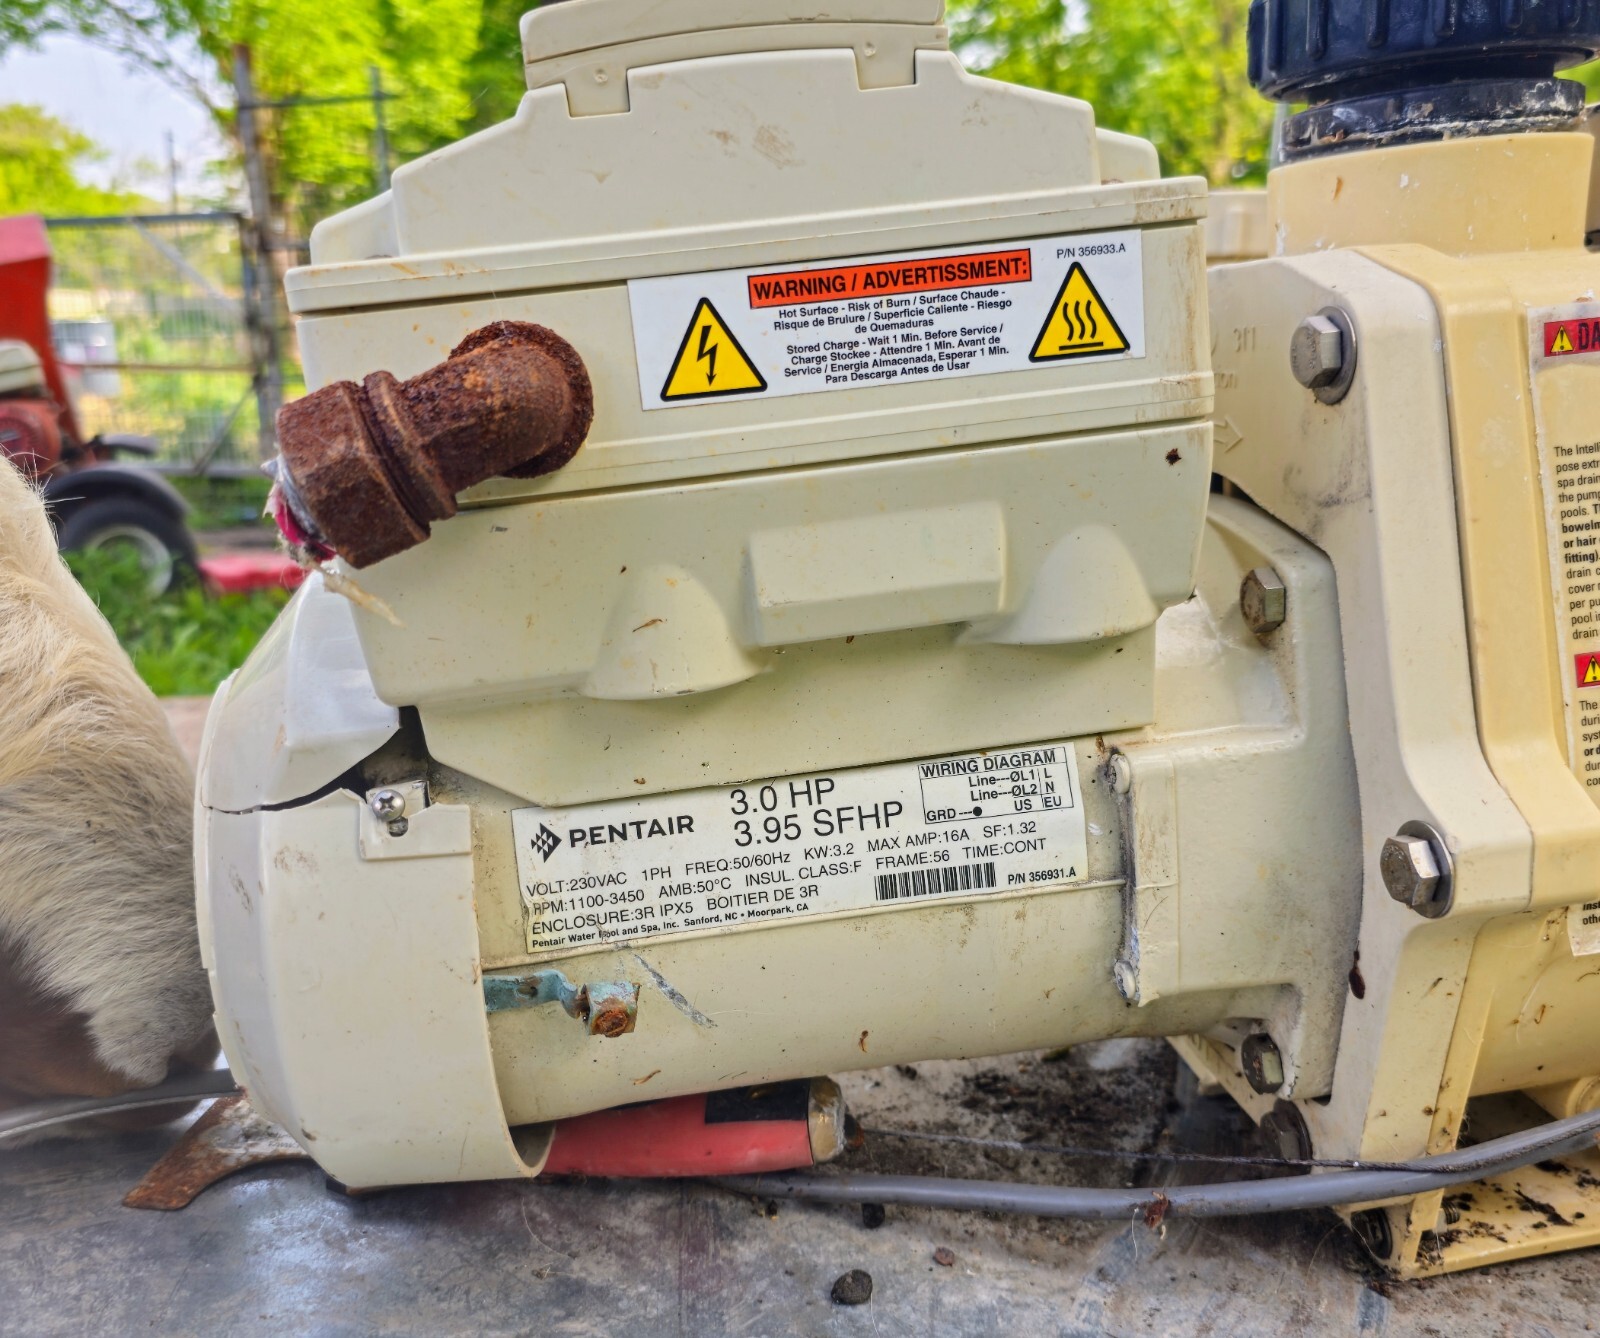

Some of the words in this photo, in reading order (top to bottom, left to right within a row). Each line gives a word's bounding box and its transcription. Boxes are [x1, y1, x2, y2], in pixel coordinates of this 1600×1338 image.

[1056, 248, 1075, 259] P/N
[1078, 243, 1126, 257] 356933.A
[753, 275, 846, 300] WARNING
[851, 273, 857, 291] /
[863, 258, 1027, 290] ADVERTISSMENT:
[779, 308, 797, 319] Hot
[800, 306, 838, 317] Surface
[848, 301, 870, 312] Risk
[873, 300, 883, 310] of
[886, 298, 911, 309] Burn
[919, 294, 958, 305] Surface
[960, 289, 999, 300] Chaude
[774, 320, 809, 331] Risque
[812, 317, 825, 327] de
[828, 314, 865, 326] Brulure
[874, 307, 925, 321] Superficie
[927, 302, 968, 315] Caliente
[977, 300, 1012, 311] Riesgo
[855, 325, 867, 334] de
[870, 319, 934, 332] Quemaduras
[787, 343, 820, 355] Stored
[823, 340, 860, 351] Charge
[867, 336, 890, 347] Wait
[892, 335, 897, 344] 1
[901, 332, 922, 344] Min.
[925, 329, 958, 340] Before
[960, 325, 997, 337] Service
[791, 354, 827, 365] Charge
[830, 350, 870, 361] Stockee
[880, 343, 923, 356] Attendre
[925, 343, 931, 351] 1
[934, 341, 955, 351] Min.
[957, 338, 986, 348] Avant
[988, 336, 1000, 344] de
[784, 366, 822, 377] Service
[830, 361, 869, 373] Energia
[871, 353, 936, 368] Almacenada,
[938, 350, 977, 362] Esperar
[980, 347, 985, 356] 1
[988, 345, 1010, 356] Min.
[825, 374, 848, 384] Para
[851, 368, 898, 382] Descarga
[900, 366, 929, 376] Antes
[932, 363, 944, 372] de
[947, 361, 970, 371] Usar
[1553, 446, 1573, 457] The
[1555, 462, 1580, 475] pose
[1557, 478, 1575, 490] spa
[1558, 492, 1575, 503] the
[1560, 505, 1590, 520] pools.
[1563, 540, 1574, 549] or
[1576, 534, 1597, 547] hair
[1566, 567, 1592, 579] drain
[1568, 583, 1596, 595] cover
[1569, 600, 1586, 612] per
[1571, 611, 1593, 627] pool
[1572, 627, 1599, 640] drain
[1579, 700, 1598, 711] The
[1584, 748, 1594, 757] or
[921, 760, 979, 778] WIRING
[983, 750, 1057, 770] DIAGRAM
[730, 785, 778, 816] 3.0
[788, 777, 835, 808] HP
[926, 808, 957, 822] GRD
[1014, 798, 1033, 812] US
[1043, 795, 1062, 808] EU
[569, 815, 695, 848] PENTAIR
[734, 814, 802, 847] 3.95
[813, 800, 904, 837] SFHP
[526, 871, 628, 898] VOLT:230VAC
[641, 866, 672, 882] 1PH
[685, 851, 791, 876] FREQ:50/60Hz
[804, 842, 855, 861] KW:3.2
[868, 836, 901, 853] MAX
[905, 829, 970, 848] AMP:16A
[983, 821, 1037, 839] SF:1.32
[533, 889, 645, 916] RPM:1100-3450
[658, 877, 732, 899] AMB:50°C
[745, 870, 795, 888] INSUL.
[798, 861, 863, 880] CLASS:F
[875, 850, 950, 870] FRAME:56
[962, 838, 1047, 860] TIME:CONT
[1007, 872, 1026, 885] P/N
[1029, 866, 1077, 882] 356931.A
[532, 906, 655, 935] ENCLOSURE:3R
[660, 901, 694, 917] IPX5
[706, 891, 769, 911] BOITIER
[773, 887, 795, 902] DE
[800, 884, 819, 898] 3R
[532, 937, 566, 948] Pentair
[568, 933, 596, 946] Water
[622, 926, 639, 937] and
[641, 924, 661, 936] Spa,
[663, 920, 680, 931] Inc.
[684, 915, 723, 928] Sanford,
[724, 912, 738, 921] NC
[747, 904, 795, 919] Moorpark,
[796, 903, 809, 912] CA
